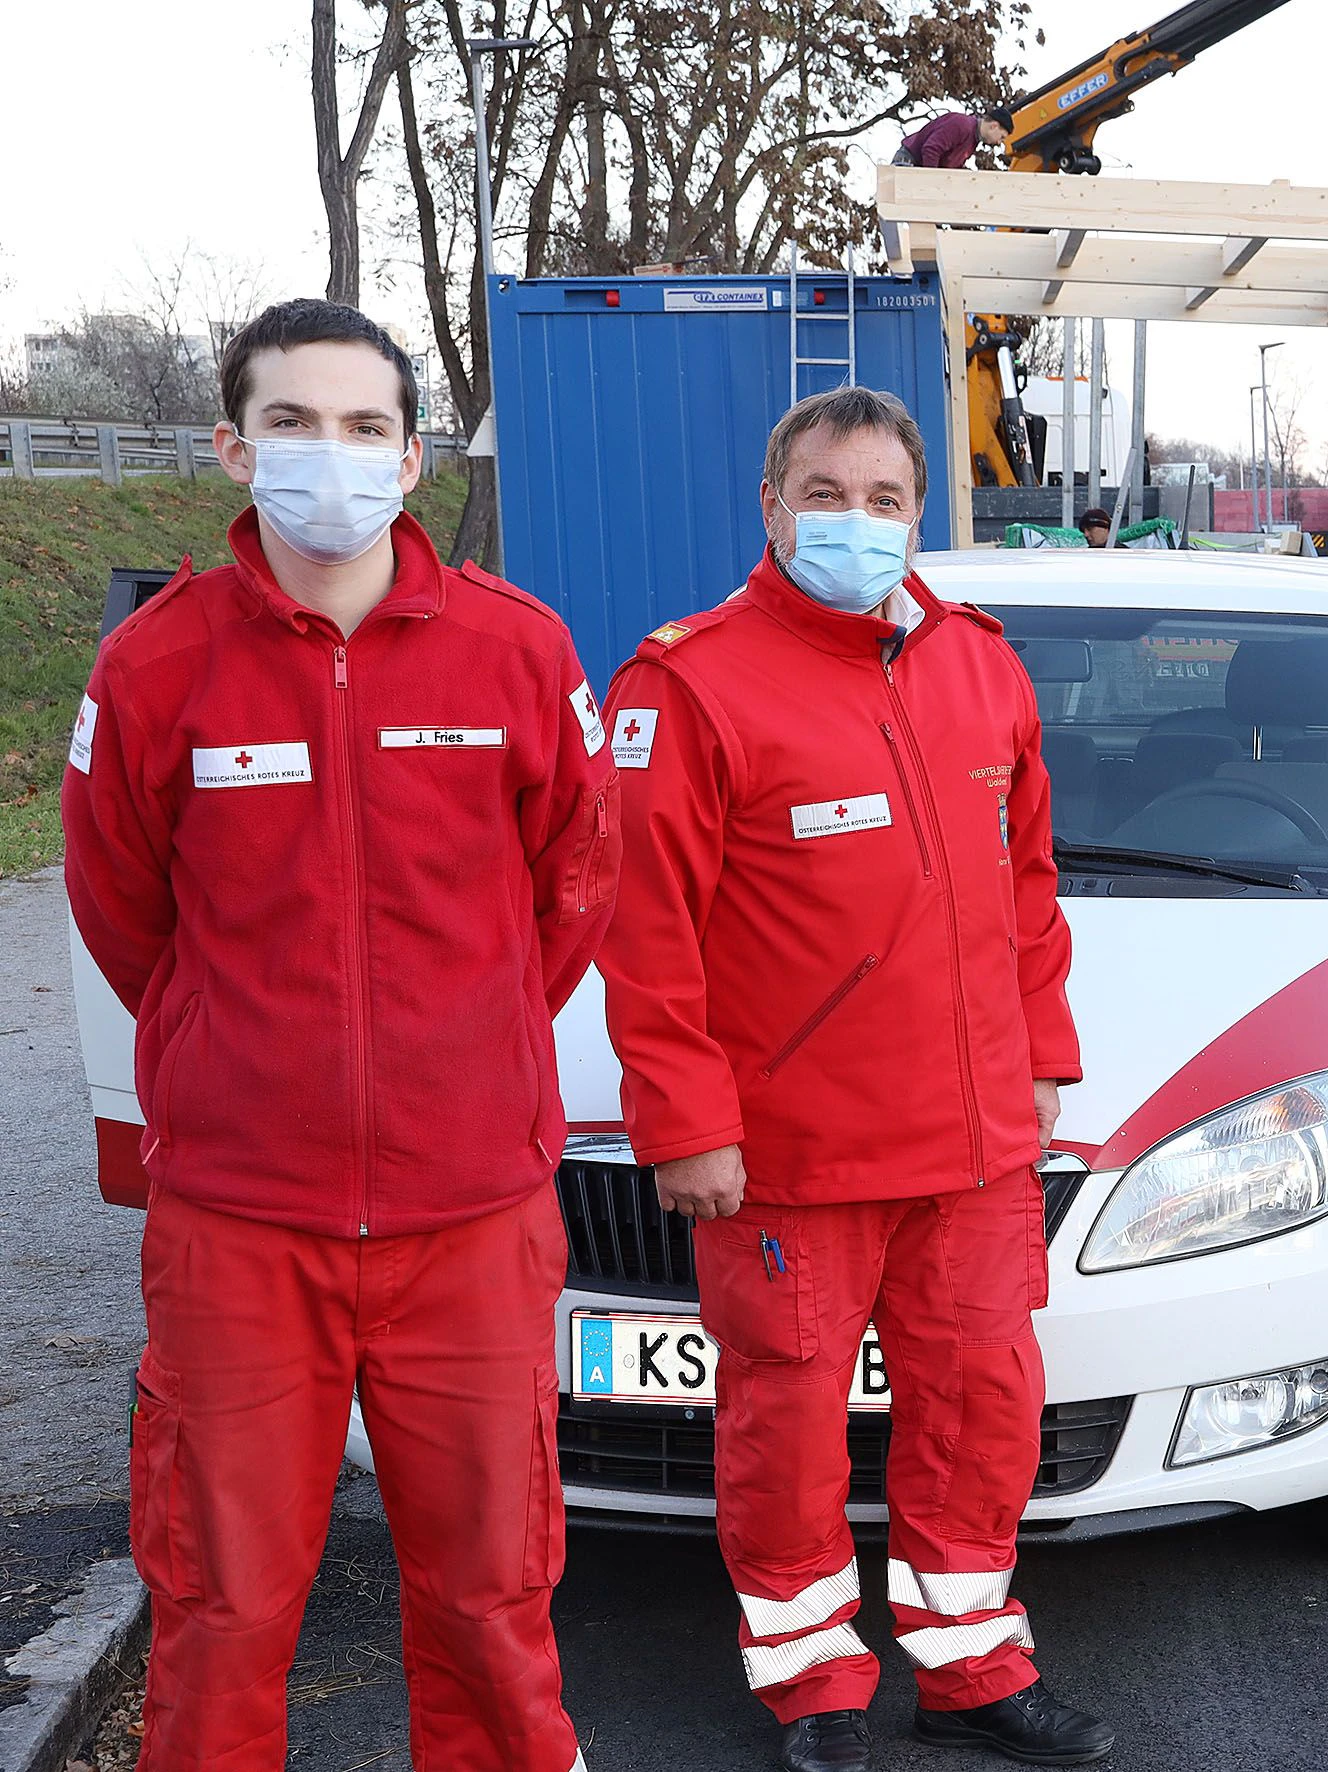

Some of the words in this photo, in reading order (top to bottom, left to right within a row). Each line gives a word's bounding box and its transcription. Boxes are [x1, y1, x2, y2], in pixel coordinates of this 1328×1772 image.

[1060, 74, 1105, 108] EFFER
[717, 293, 764, 301] CONTAINEX
[876, 296, 935, 307] 182003501
[415, 732, 426, 743] J.
[434, 731, 464, 743] Fries
[257, 771, 280, 780] ROTES
[851, 818, 868, 826] ROTES
[869, 815, 887, 823] KREUZ
[639, 1332, 706, 1389] KS
[589, 1366, 606, 1384] A
